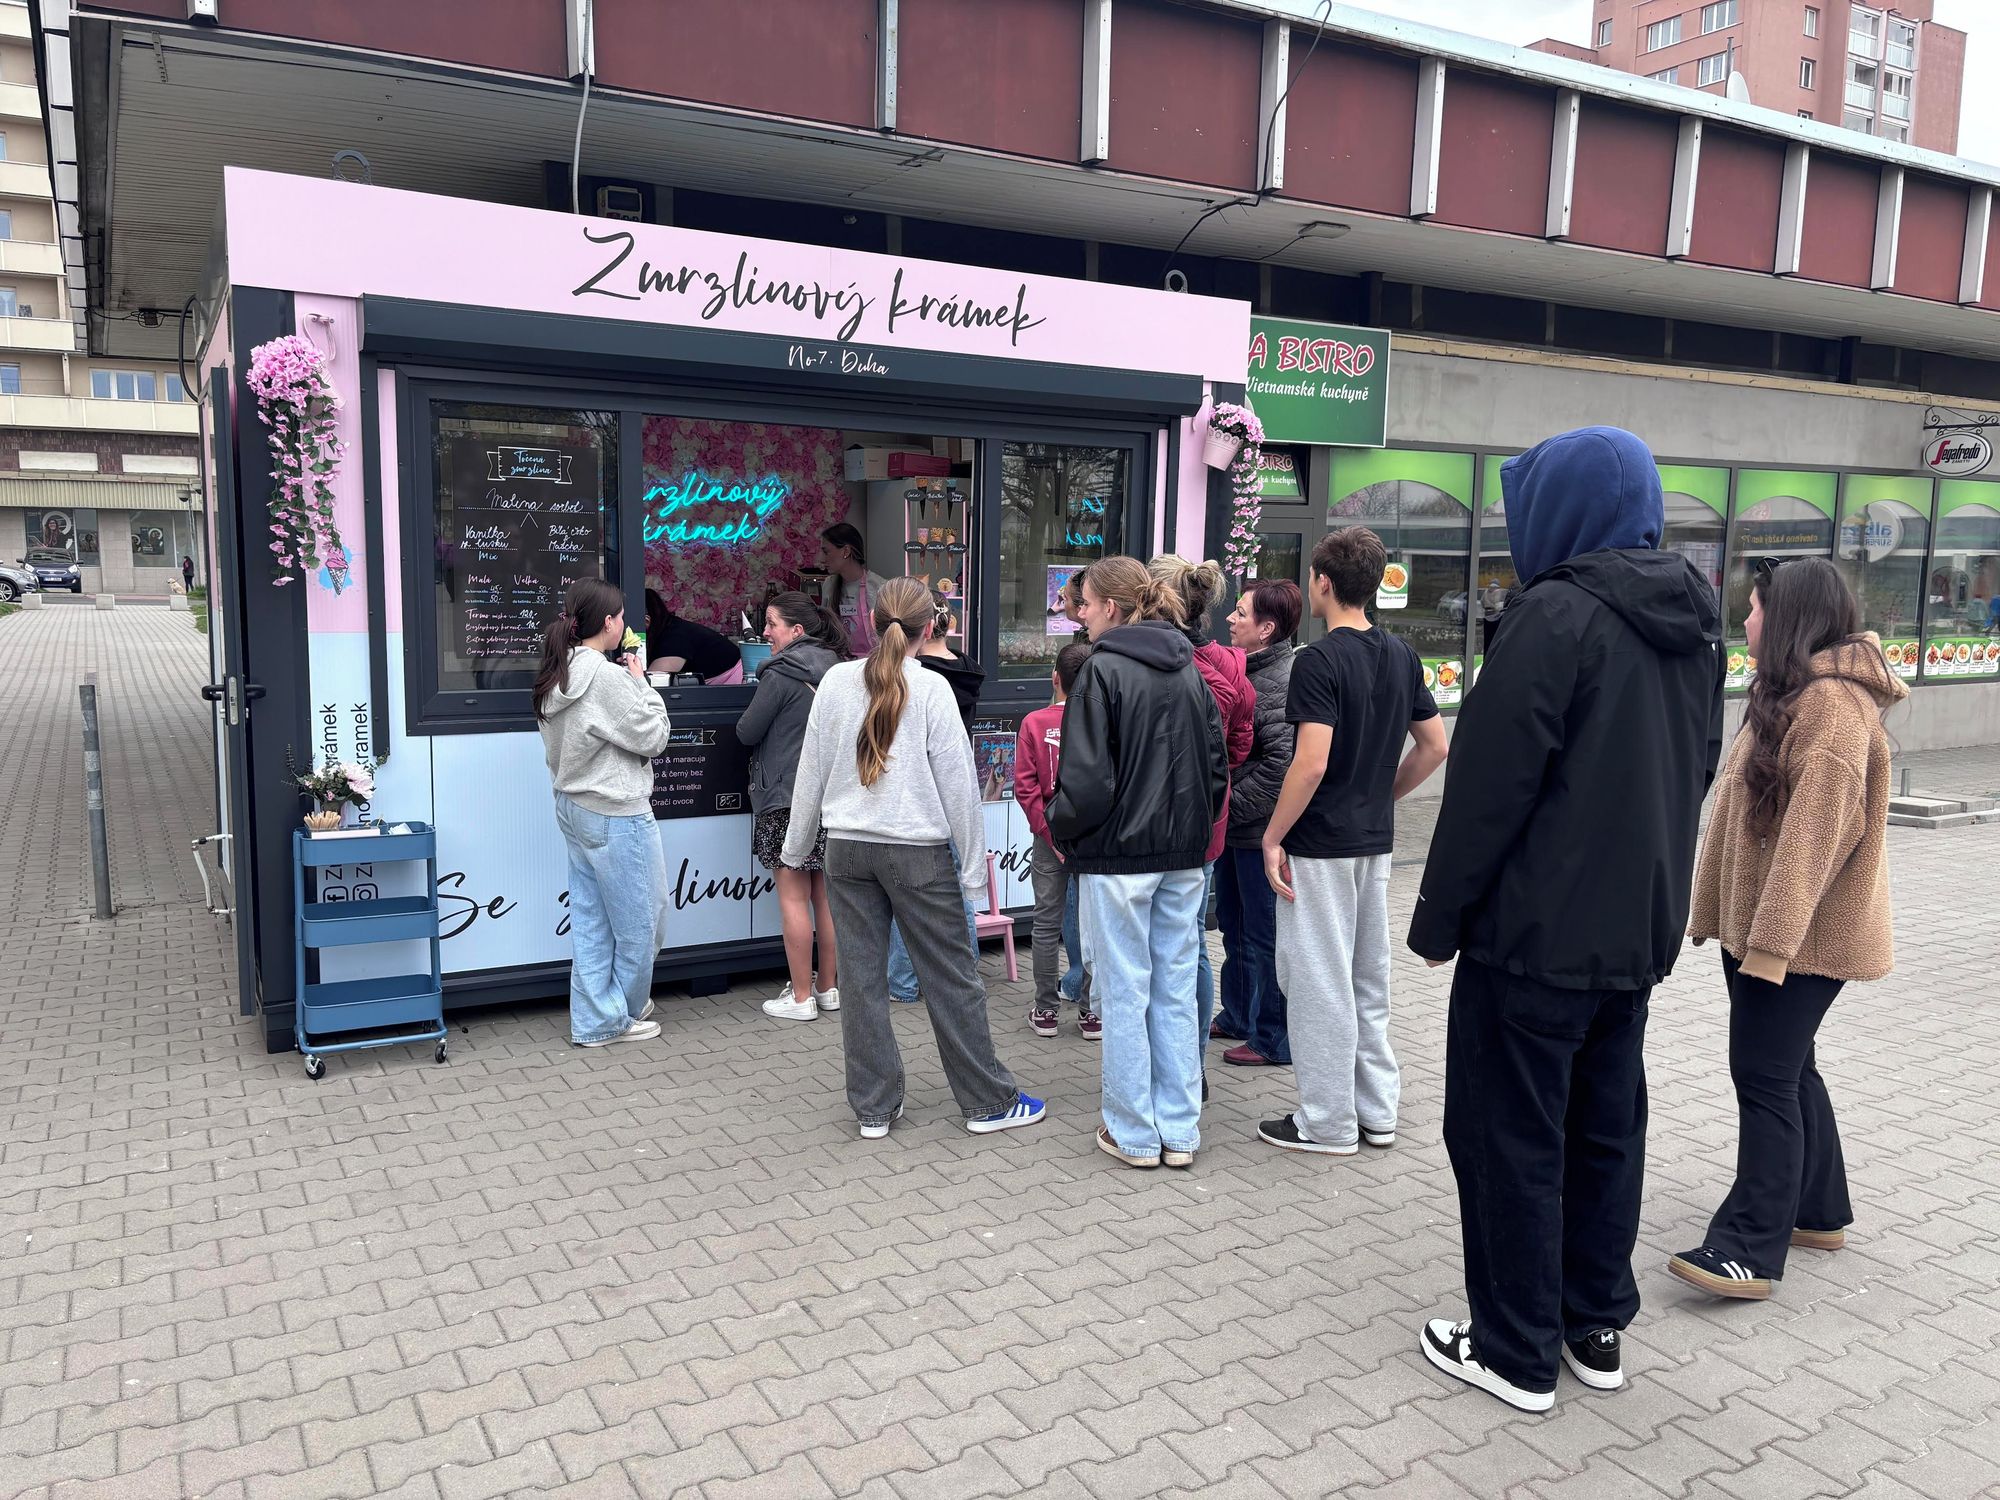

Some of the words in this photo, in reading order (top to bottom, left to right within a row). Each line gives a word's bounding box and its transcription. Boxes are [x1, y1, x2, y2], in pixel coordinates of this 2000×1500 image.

[572, 226, 876, 342] Zmrzlinový
[887, 267, 1047, 347] krámek
[841, 349, 890, 376] Duha
[1277, 336, 1375, 377] BISTRO
[1246, 376, 1316, 398] Vietnamská
[1320, 382, 1369, 404] kuchyně
[1930, 440, 1981, 466] Segafredo
[486, 488, 543, 512] Malina
[465, 524, 511, 540] Vanilka
[478, 550, 499, 561] Mix
[559, 552, 579, 563] Mix
[665, 756, 671, 764] &
[672, 755, 706, 764] maracuja
[668, 769, 689, 778] černý
[669, 784, 675, 792] &
[676, 783, 702, 791] limetka
[651, 798, 671, 807] Dračí
[437, 872, 518, 940] Se
